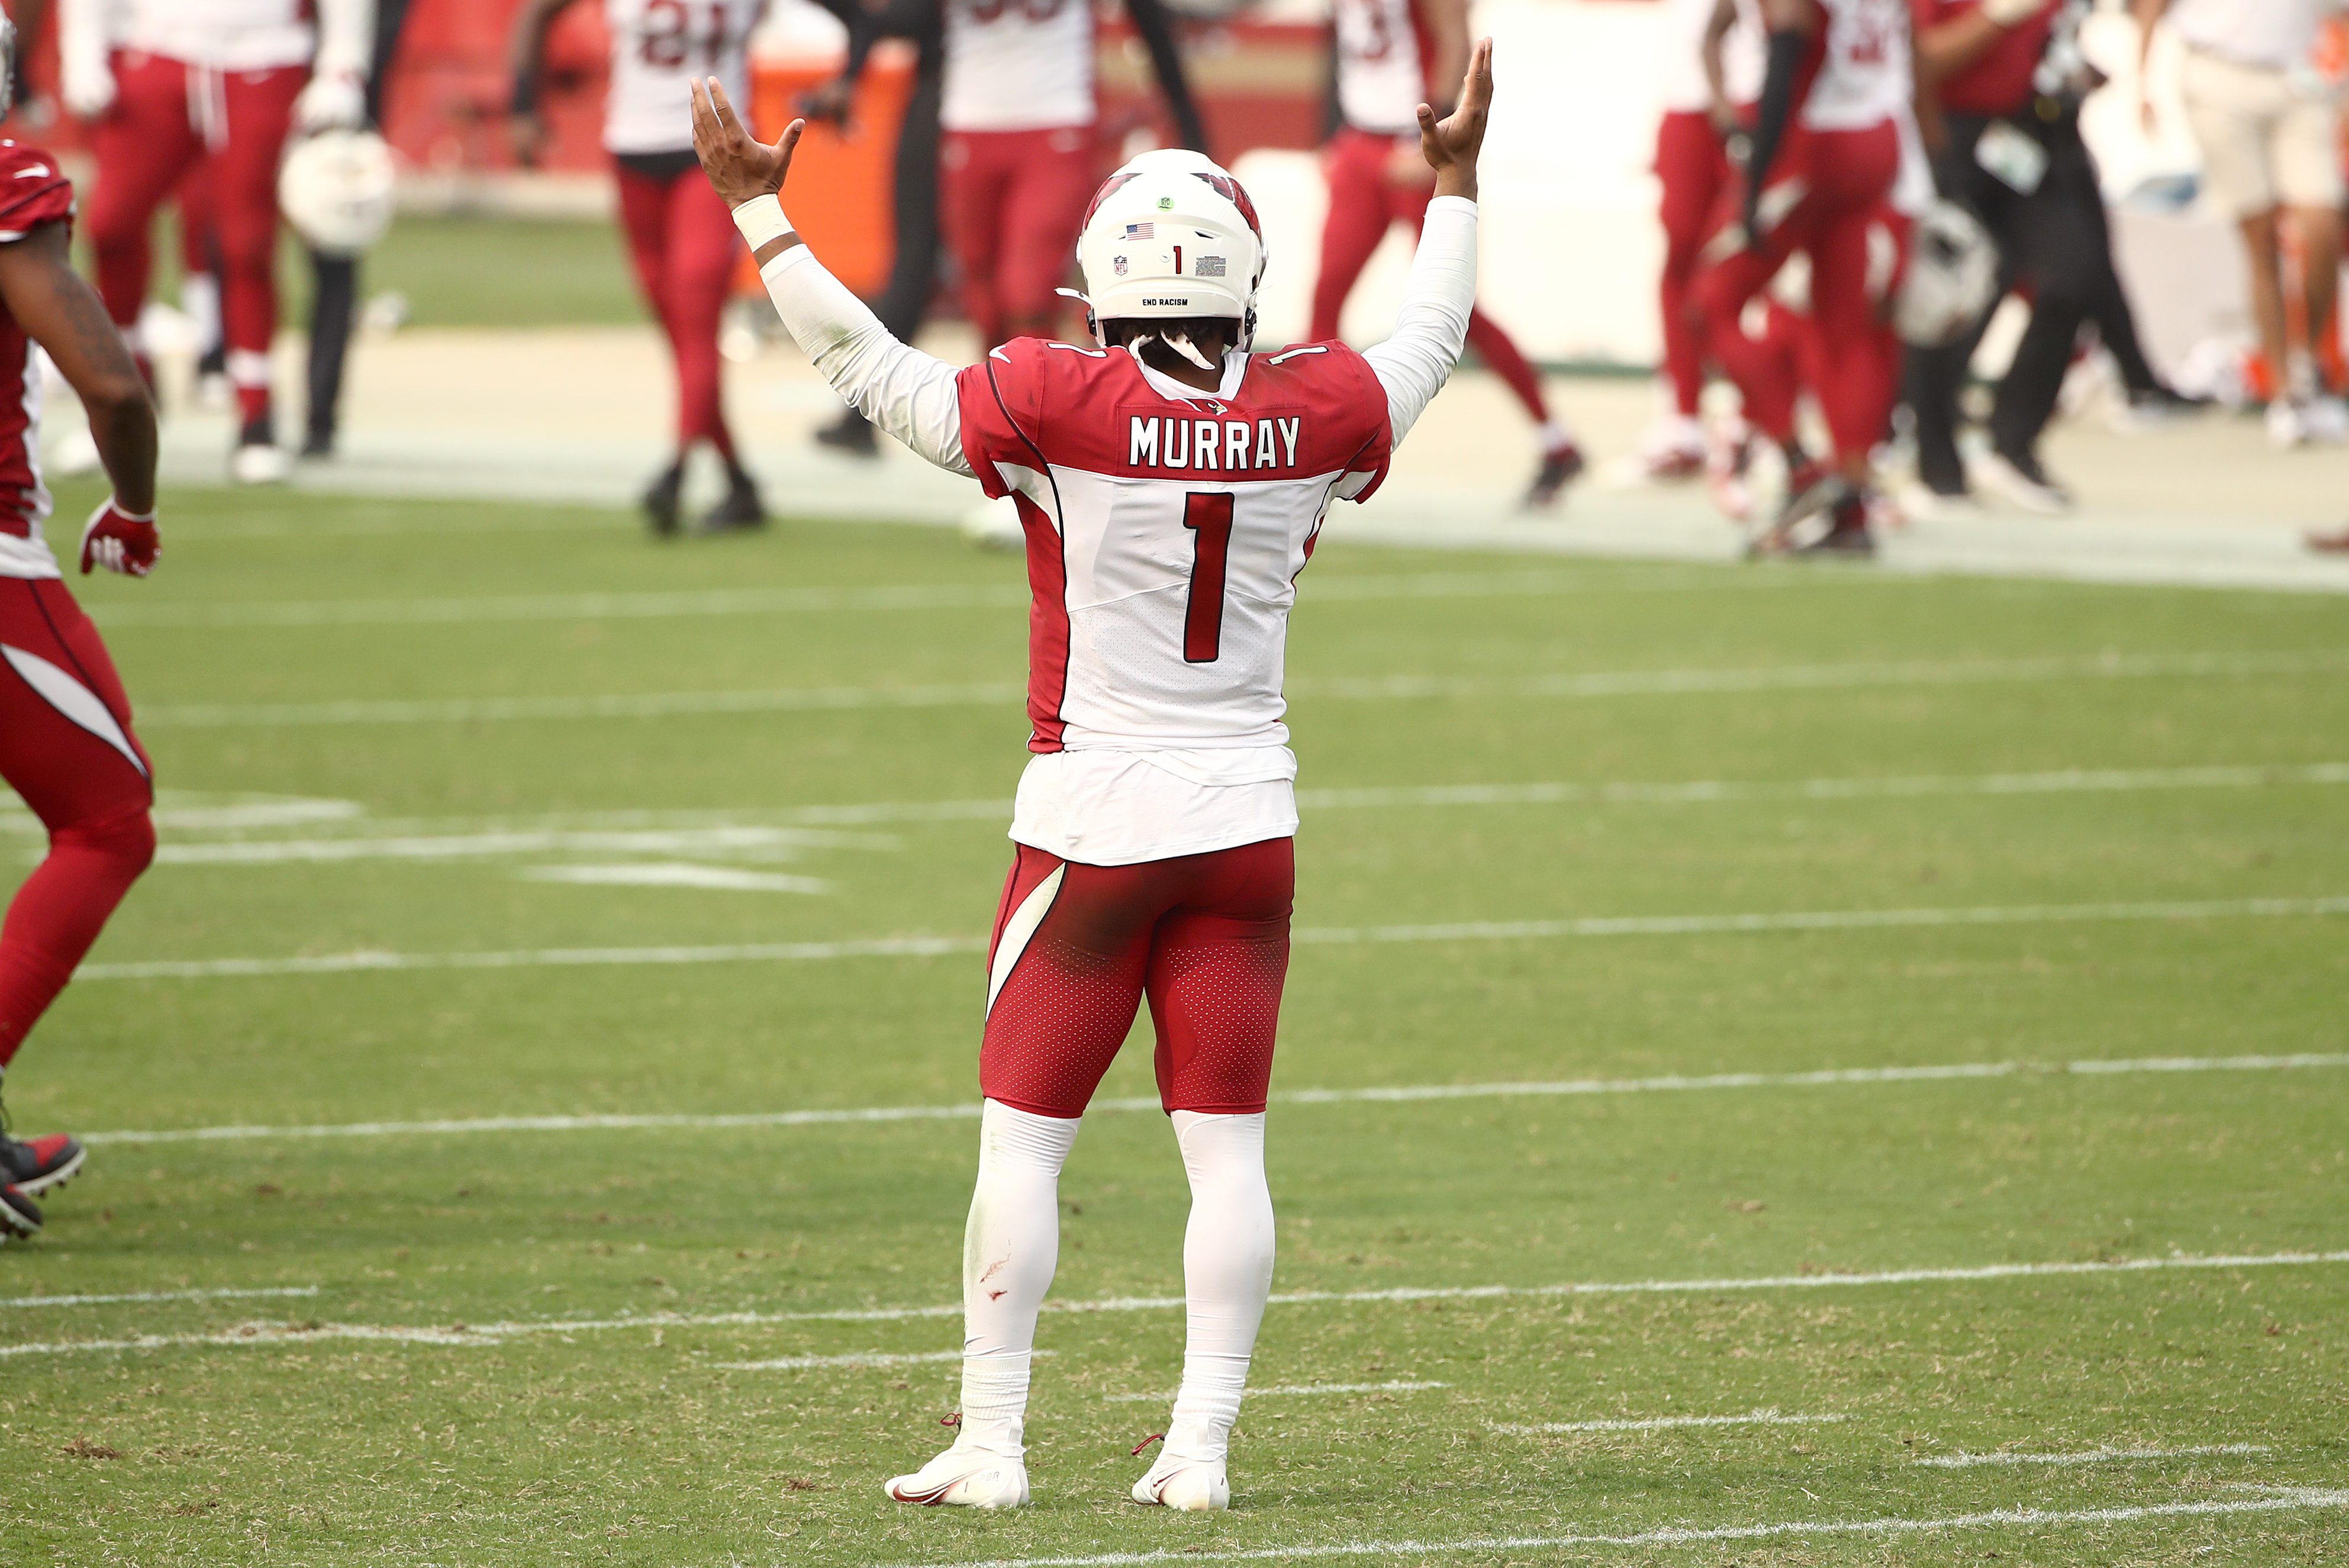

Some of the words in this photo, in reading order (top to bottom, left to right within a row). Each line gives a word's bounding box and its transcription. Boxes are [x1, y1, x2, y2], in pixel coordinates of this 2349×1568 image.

[1116, 264, 1127, 273] NFL
[1173, 246, 1182, 274] 1
[1129, 415, 1300, 470] MURRAY
[1183, 491, 1235, 663] 1
